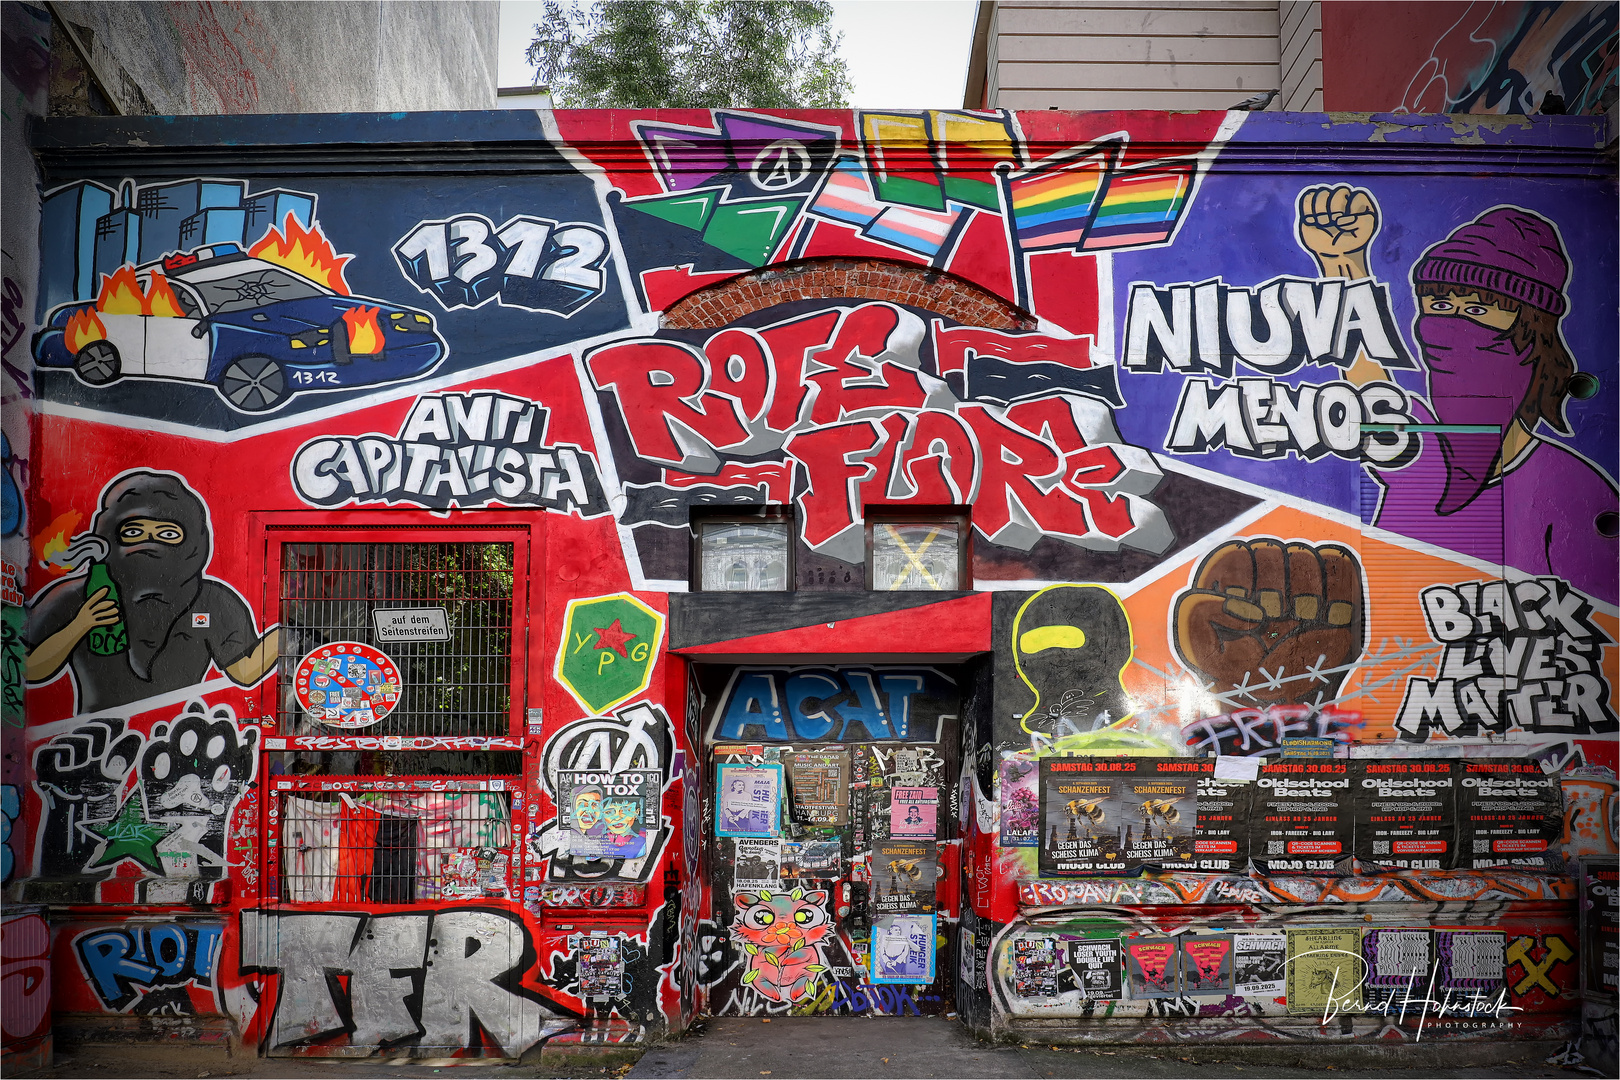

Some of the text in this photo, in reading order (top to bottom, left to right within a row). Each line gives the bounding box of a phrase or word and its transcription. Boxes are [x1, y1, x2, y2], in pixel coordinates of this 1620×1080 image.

[394, 216, 608, 300] 1312
[1123, 279, 1400, 368] NIUVA
[292, 370, 342, 385] 1312
[586, 303, 930, 464] ROTE
[402, 393, 540, 442] ANTI
[1169, 380, 1410, 460] MENOS
[298, 433, 593, 507] CAPITALISTA
[1421, 578, 1592, 642] BLACK
[392, 614, 430, 625] auf dem
[381, 626, 444, 637] Seitenstreifen
[91, 631, 126, 652] DIY
[1442, 635, 1594, 682] LIVES
[1396, 670, 1608, 736] MATTER
[1180, 703, 1362, 757] FREE
[1050, 762, 1137, 772] SAMSTAG 30.08.25
[1156, 763, 1200, 772] SAMSTAG
[1261, 764, 1347, 774] SAMSTAG 30.08.25
[1365, 763, 1451, 774] SAMSTAG 30.08.25
[1465, 763, 1510, 773] SAMSTAG
[574, 773, 616, 785] HOW
[618, 773, 645, 785] TO
[1256, 778, 1350, 788] Oldschool
[1361, 777, 1453, 788] Oldschool
[1460, 777, 1554, 788] Oldschool
[603, 784, 640, 796] TOX
[896, 790, 909, 800] FREE
[1058, 785, 1111, 794] SCHANZENFEST
[1133, 786, 1187, 794] SCHANZENFEST
[1273, 787, 1333, 797] Beats
[1378, 787, 1437, 797] Beats
[1478, 787, 1539, 797] Beats
[760, 789, 770, 825] HUER
[795, 809, 839, 817] HAMBURG
[1057, 840, 1092, 850] GEGEN DAS
[1132, 840, 1167, 850] GEGEN DAS
[881, 847, 927, 855] SCHANZENFEST
[1051, 848, 1099, 859] SCHEISS KLIMA
[1126, 848, 1174, 859] SCHEISS KLIMA
[1057, 862, 1126, 870] MOJO CLUB
[1200, 859, 1230, 869] CLUB
[1267, 860, 1335, 870] MOJO CLUB
[1410, 859, 1441, 870] CLUB
[1472, 856, 1545, 869] MOJO CLUB
[881, 893, 911, 903] GEGEN DAS
[876, 901, 917, 910] SCHEISS KLIMA
[909, 933, 918, 966] STEIK
[917, 933, 927, 969] HUNGER
[1077, 944, 1111, 952] SCHWACH
[1236, 940, 1286, 951] SCHWACH
[1095, 949, 1117, 957] YOUTH
[81, 924, 223, 1002] RIOT
[1076, 956, 1102, 964] DOUBLE
[1243, 984, 1276, 992] 19.09.2025
